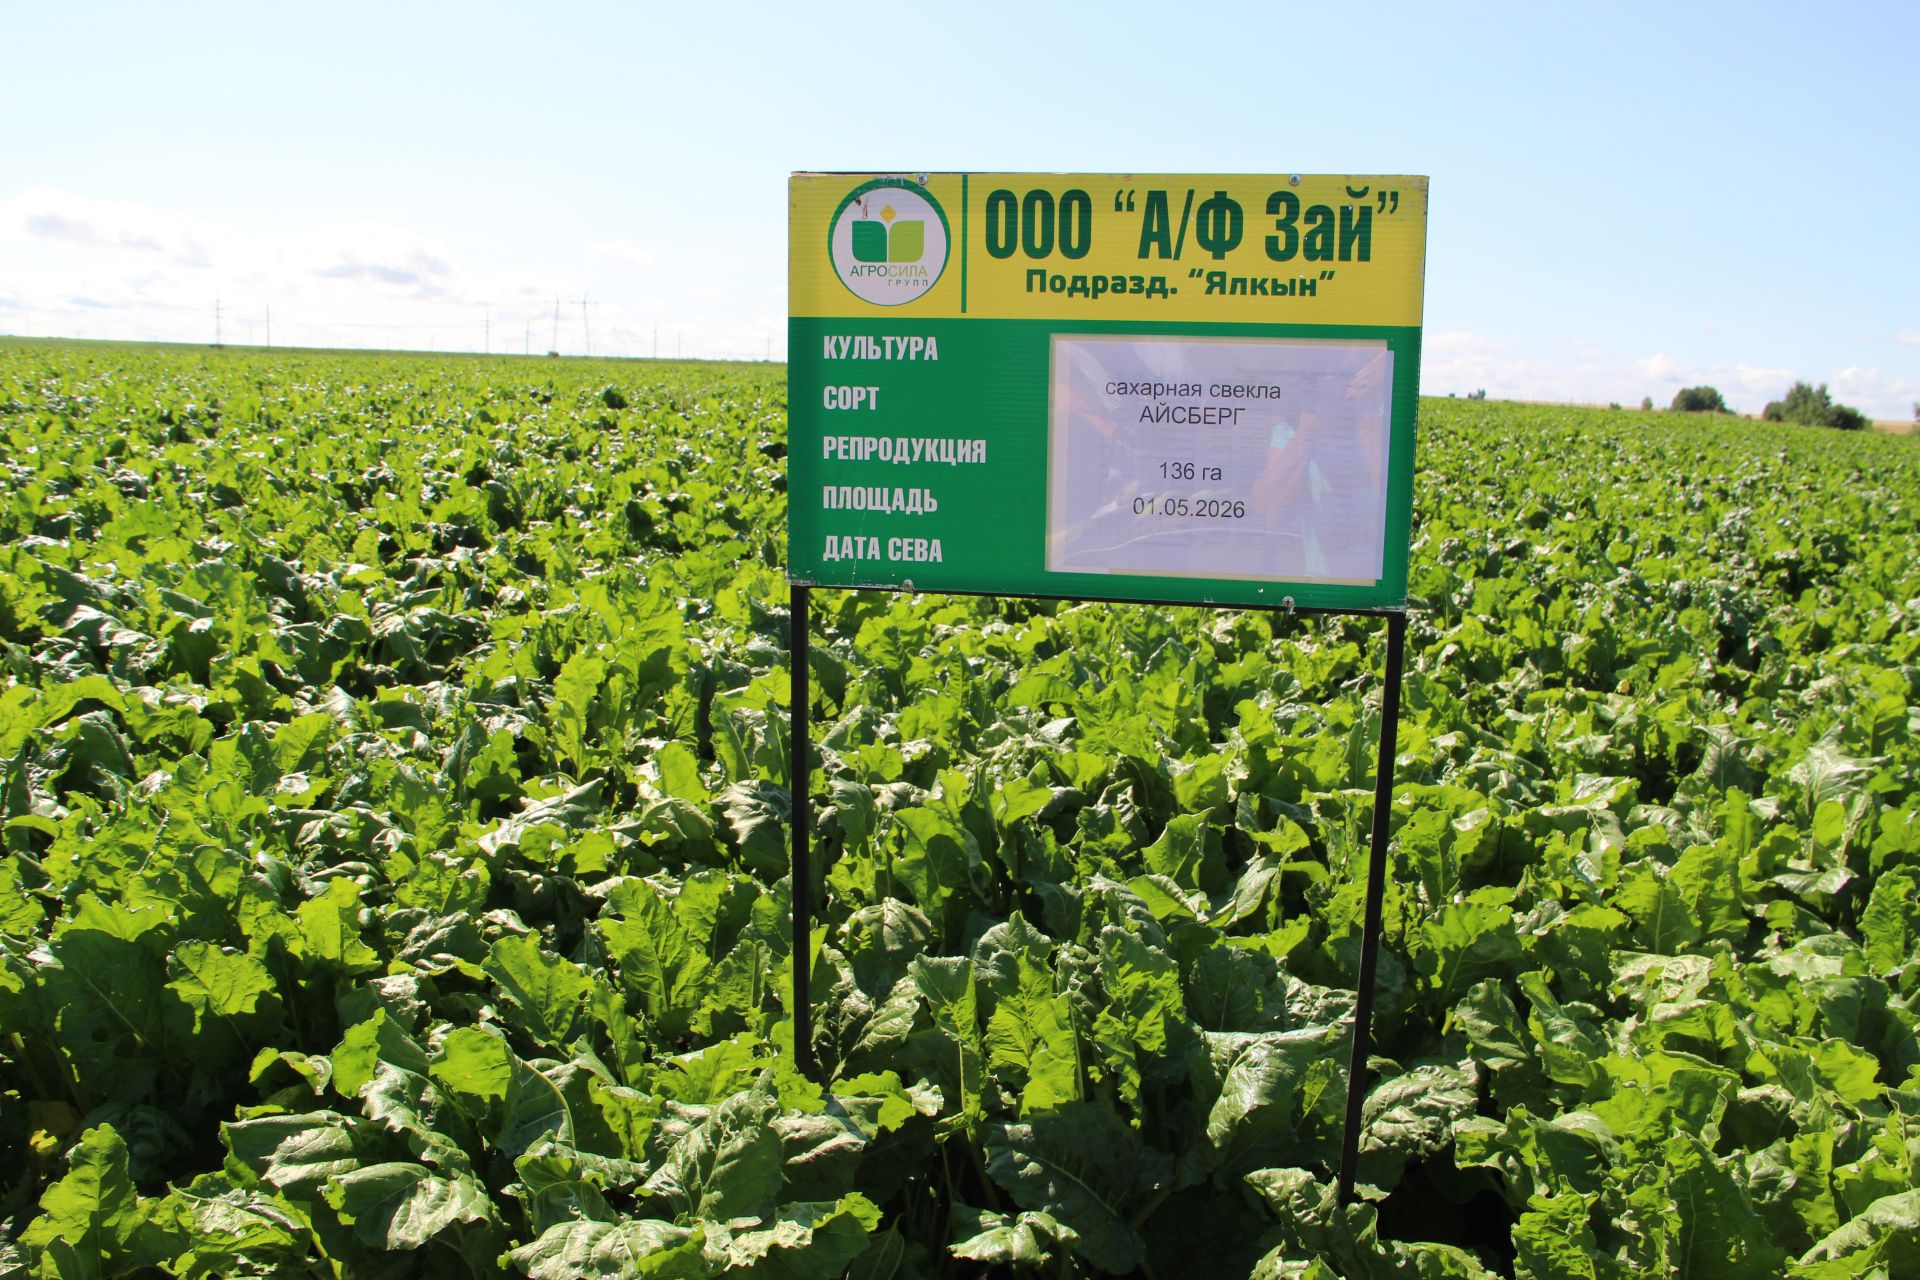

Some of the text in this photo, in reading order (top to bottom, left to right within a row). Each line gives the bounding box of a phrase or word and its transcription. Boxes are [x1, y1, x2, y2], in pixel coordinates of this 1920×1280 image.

[984, 189, 1093, 261] ООО
[850, 265, 928, 277] АГРОСИЛА
[888, 279, 929, 287] ГРУПП
[1026, 268, 1178, 300] Подразд.
[823, 335, 939, 361] КУЛЬТУРА
[823, 385, 880, 411] СОРТ
[1105, 380, 1281, 401] сахарная свекла
[1139, 402, 1246, 426] АЙСБЕРГ
[823, 436, 987, 467] РЕПРОДУКЦИЯ
[1159, 461, 1223, 481] 136 га
[823, 486, 938, 516] ПЛОЩАДЬ
[1132, 496, 1246, 519] 01.05.2026
[823, 535, 943, 563] ДАТА СЕВА
